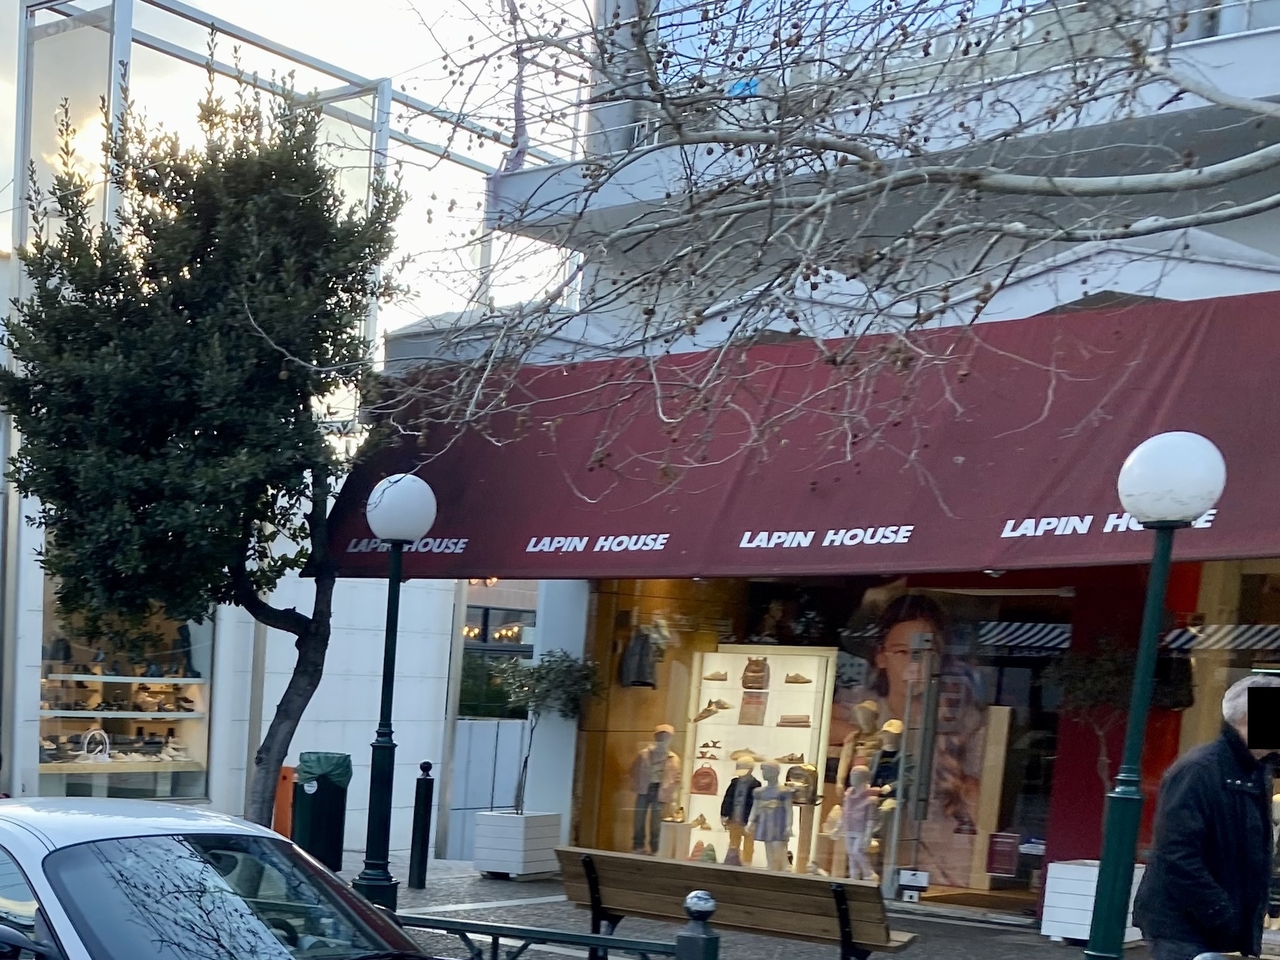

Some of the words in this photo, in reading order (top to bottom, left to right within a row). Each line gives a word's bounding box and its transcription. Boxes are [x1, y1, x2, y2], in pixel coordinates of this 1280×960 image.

[1000, 515, 1094, 538] LAPIN
[1102, 508, 1218, 533] HOE
[402, 538, 469, 553] HOUSE
[525, 536, 590, 552] LAPIN
[593, 533, 670, 552] HOUSE
[739, 530, 816, 548] LAPIN
[821, 525, 915, 547] HOUSE
